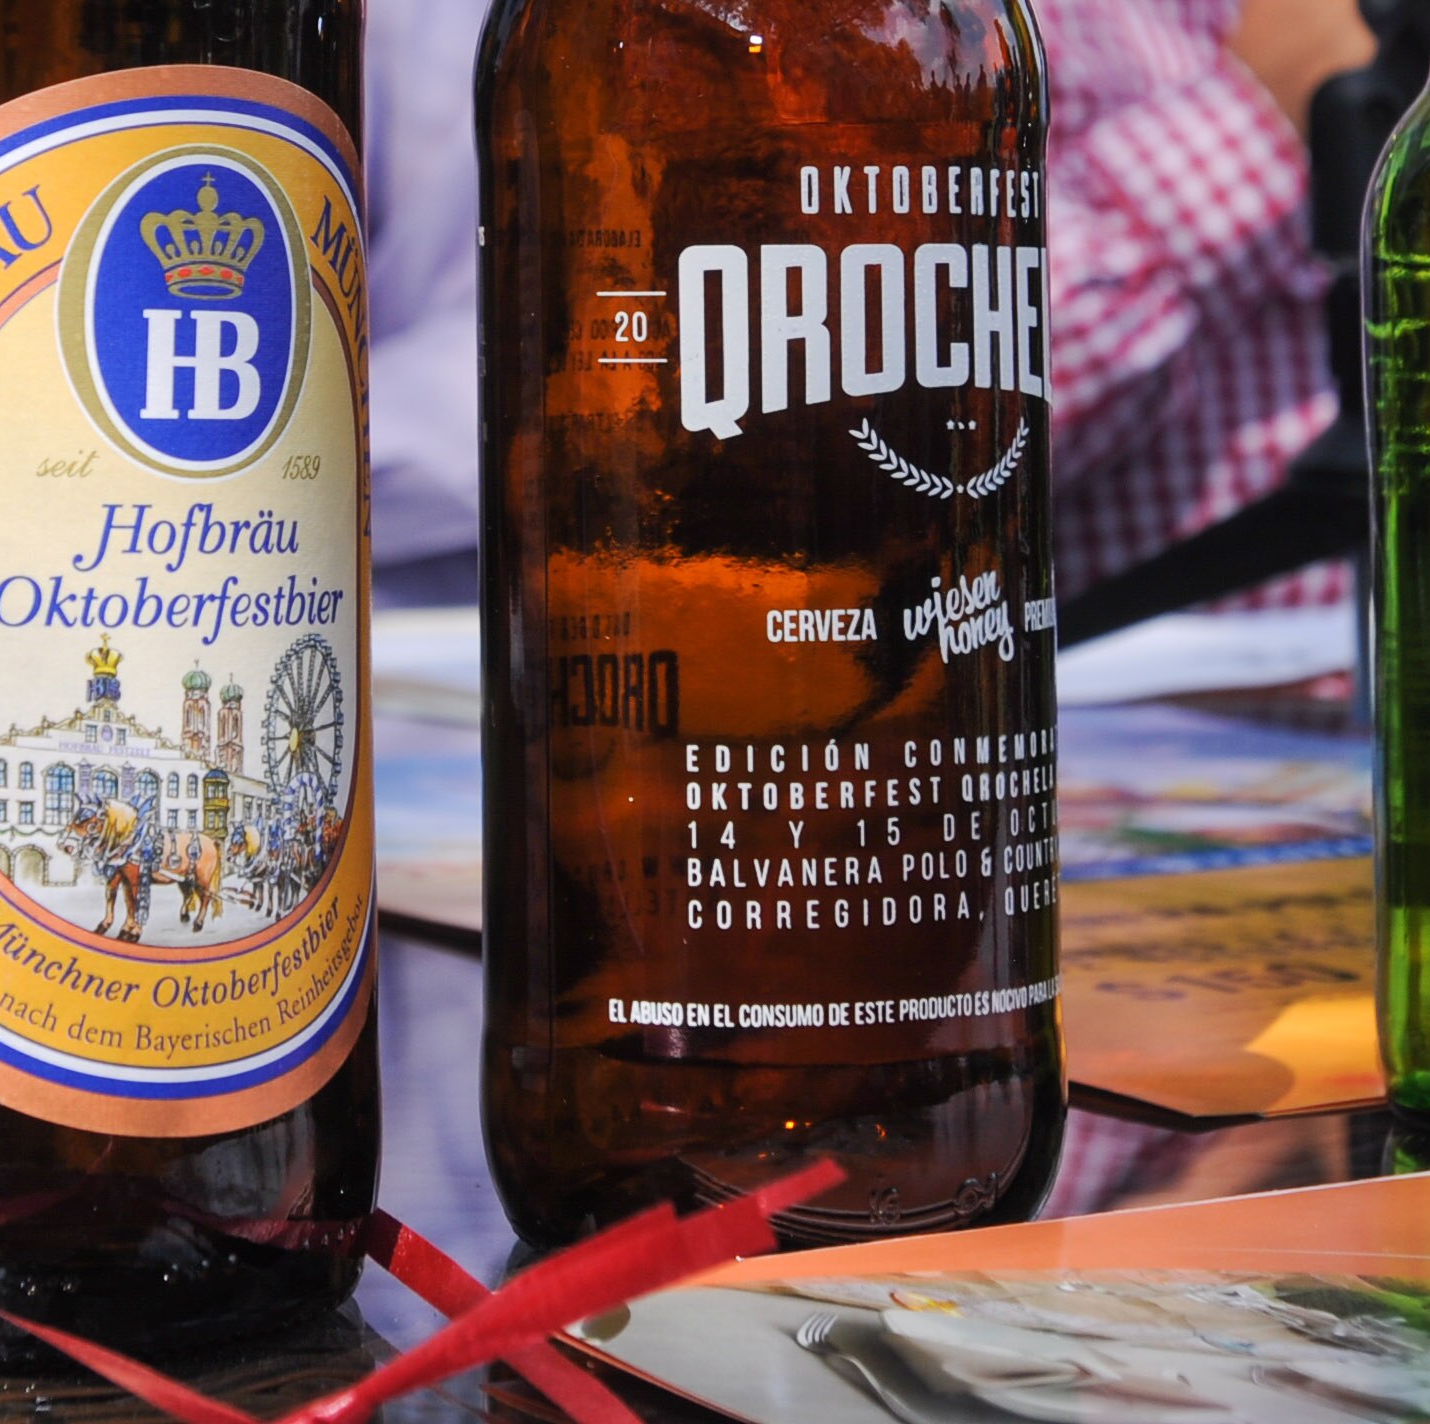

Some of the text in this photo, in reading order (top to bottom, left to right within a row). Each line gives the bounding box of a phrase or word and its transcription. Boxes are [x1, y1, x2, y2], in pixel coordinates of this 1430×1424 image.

[800, 165, 1039, 218] OKTOBERFEST
[614, 311, 648, 342] 20
[140, 309, 261, 420] HB
[36, 450, 321, 480] seit 1589
[72, 503, 299, 572] Hofbräu
[767, 608, 877, 643] CERVEZA
[903, 570, 1001, 641] wiesen
[938, 600, 1015, 664] honey
[687, 739, 870, 773] EDICIÓN
[687, 777, 942, 810] OKTOBERFEST
[688, 820, 736, 848] 14
[789, 820, 804, 848] Y
[857, 816, 901, 847] 15
[943, 811, 981, 842] DE
[687, 856, 882, 887] BALVANERA
[902, 849, 967, 882] POLO
[981, 846, 992, 877] &
[152, 896, 340, 1008] Oktoberfestbier
[609, 998, 627, 1023] EL
[630, 1000, 683, 1027] ABUSO
[686, 1003, 709, 1027] EN
[714, 1004, 734, 1028] EL
[738, 1002, 824, 1028] CONSUMO
[828, 1002, 850, 1026] DE
[855, 999, 895, 1025] ESTE
[899, 992, 971, 1021] PRODUCTO
[974, 991, 990, 1015] ES
[992, 987, 1027, 1014] NOCIVO
[67, 1009, 123, 1050] dem
[135, 1014, 273, 1059] Bayerischen
